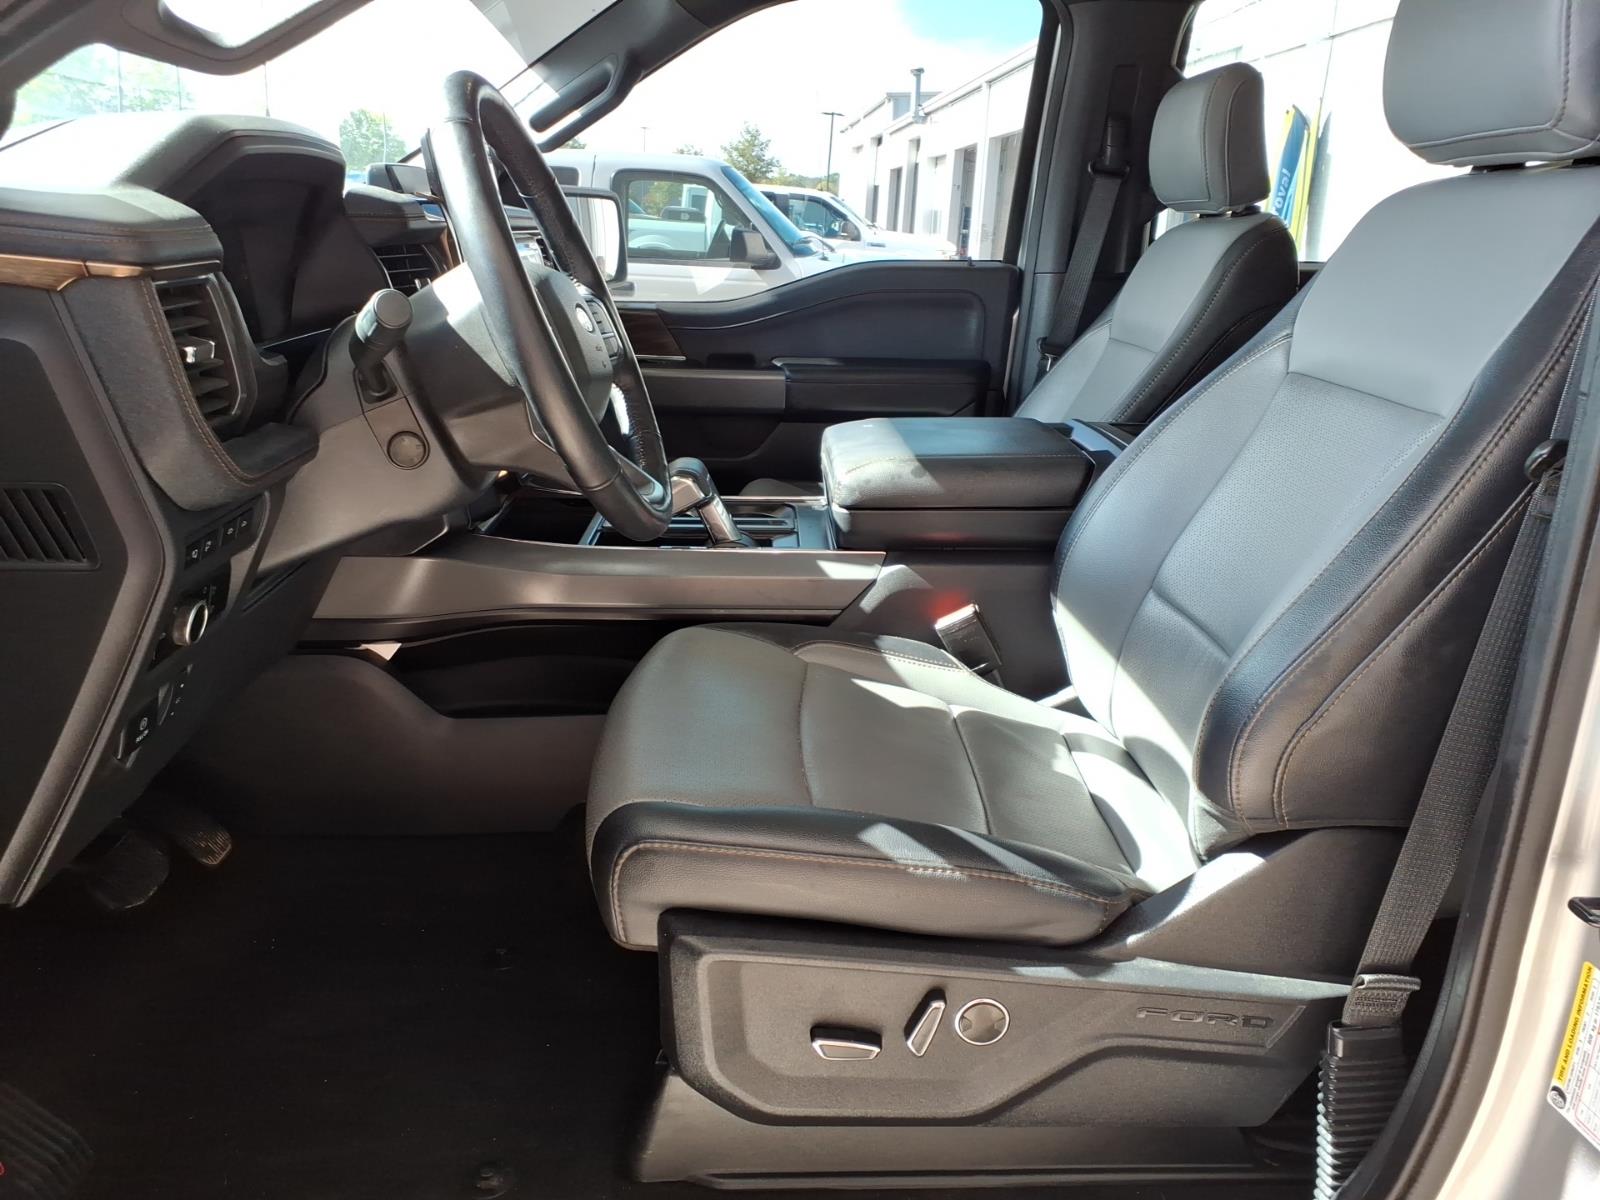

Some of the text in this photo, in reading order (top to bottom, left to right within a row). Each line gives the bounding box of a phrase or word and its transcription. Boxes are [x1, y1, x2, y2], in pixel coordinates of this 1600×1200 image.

[1136, 1006, 1274, 1028] FORD
[1562, 1048, 1571, 1065] AND
[1567, 1017, 1580, 1048] LOADING
[1576, 966, 1593, 1016] INFORMATION
